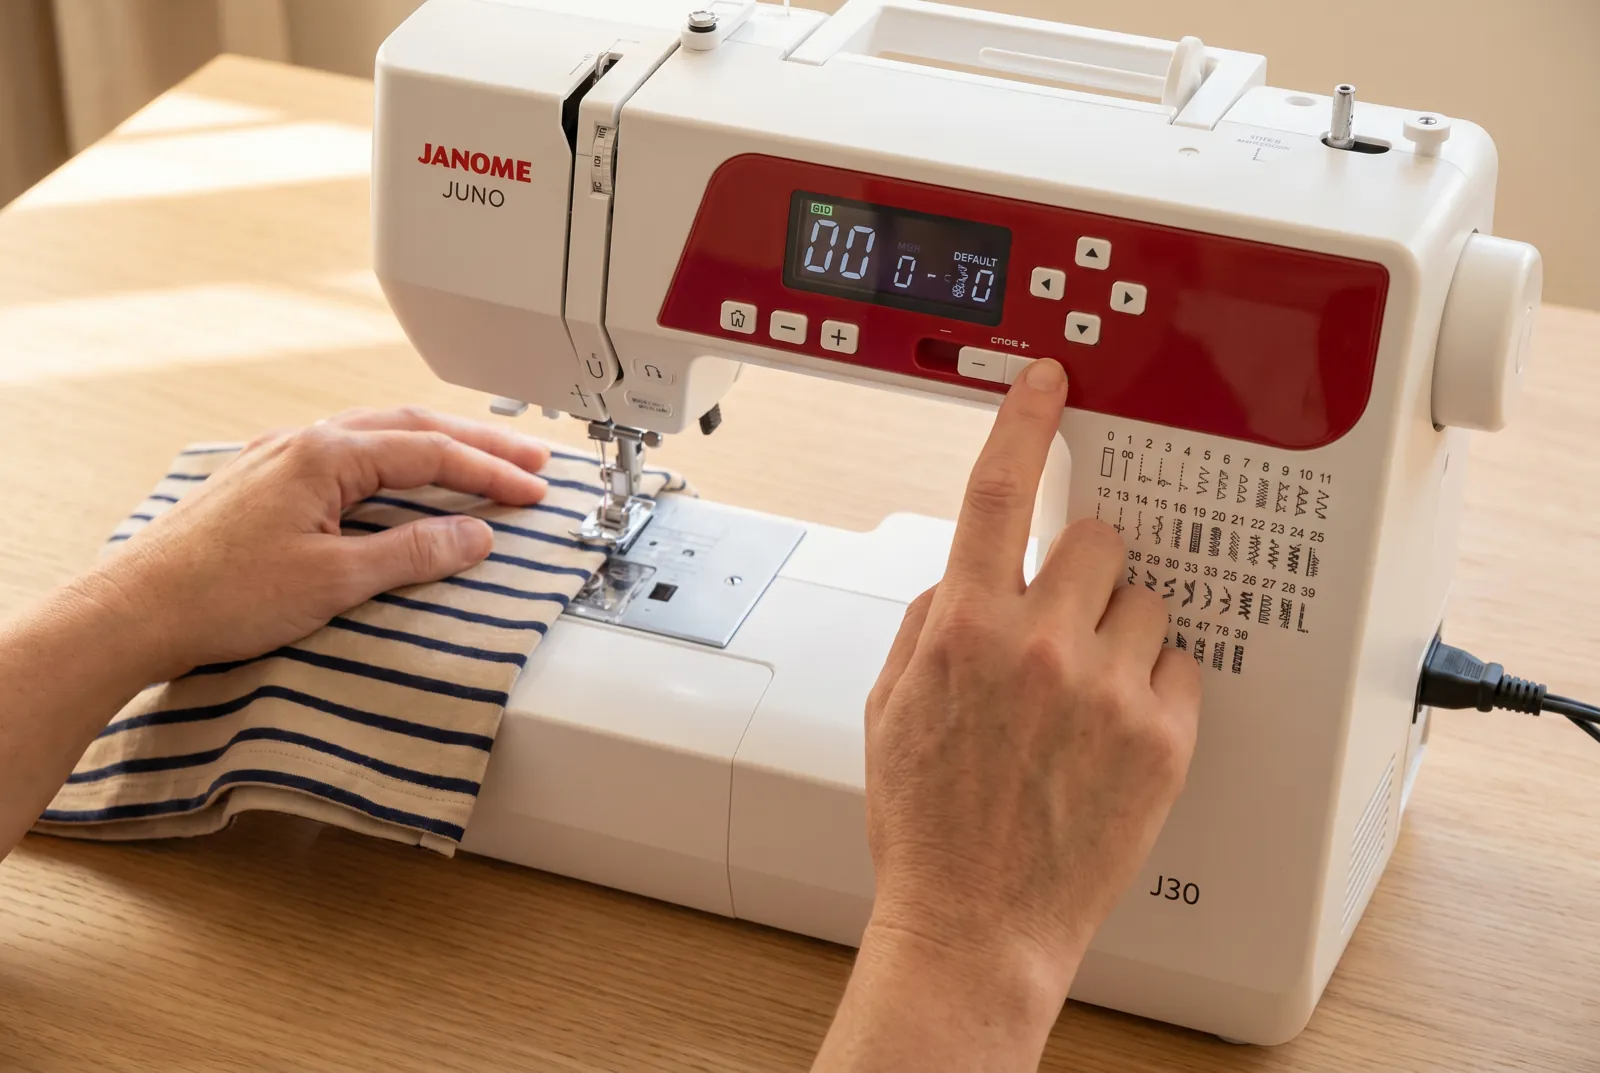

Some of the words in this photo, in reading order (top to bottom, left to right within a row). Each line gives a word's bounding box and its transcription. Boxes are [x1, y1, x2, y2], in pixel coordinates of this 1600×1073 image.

[418, 143, 532, 183] JANOME
[442, 181, 505, 207] JUNO
[804, 219, 876, 280] 00
[953, 251, 998, 267] DEFAULT
[1108, 431, 1114, 441] 0
[1127, 435, 1132, 445] 1
[1146, 439, 1153, 449] 2
[1165, 443, 1172, 452] 3
[1184, 447, 1191, 456] 4
[1204, 450, 1211, 460] 5
[1223, 454, 1230, 464] 6
[1244, 458, 1250, 467] 7
[1262, 462, 1269, 472] 8
[1282, 466, 1289, 476] 9
[1300, 469, 1313, 480] 10
[1320, 473, 1331, 484] 11
[1098, 487, 1110, 498] 12
[1117, 491, 1129, 501] 13
[1136, 495, 1148, 505] 14
[1155, 499, 1167, 509] 15
[1174, 503, 1186, 514] 16
[1194, 507, 1206, 517] 19
[1212, 511, 1226, 522] 20
[1231, 515, 1244, 526] 21
[1251, 519, 1265, 530] 22
[1270, 523, 1284, 534] 23
[1290, 527, 1304, 538] 24
[1310, 531, 1324, 542] 25
[1128, 550, 1141, 561] 38
[1146, 554, 1160, 565] 29
[1165, 558, 1179, 569] 30
[1184, 562, 1198, 573] 33
[1204, 566, 1217, 577] 33
[1223, 570, 1237, 581] 25
[1242, 574, 1256, 585] 26
[1262, 578, 1276, 589] 27
[1282, 582, 1295, 594] 28
[1301, 587, 1315, 598] 39
[1177, 617, 1190, 627] 66
[1196, 621, 1210, 631] 47
[1216, 625, 1229, 636] 78
[1150, 875, 1200, 905] J30
